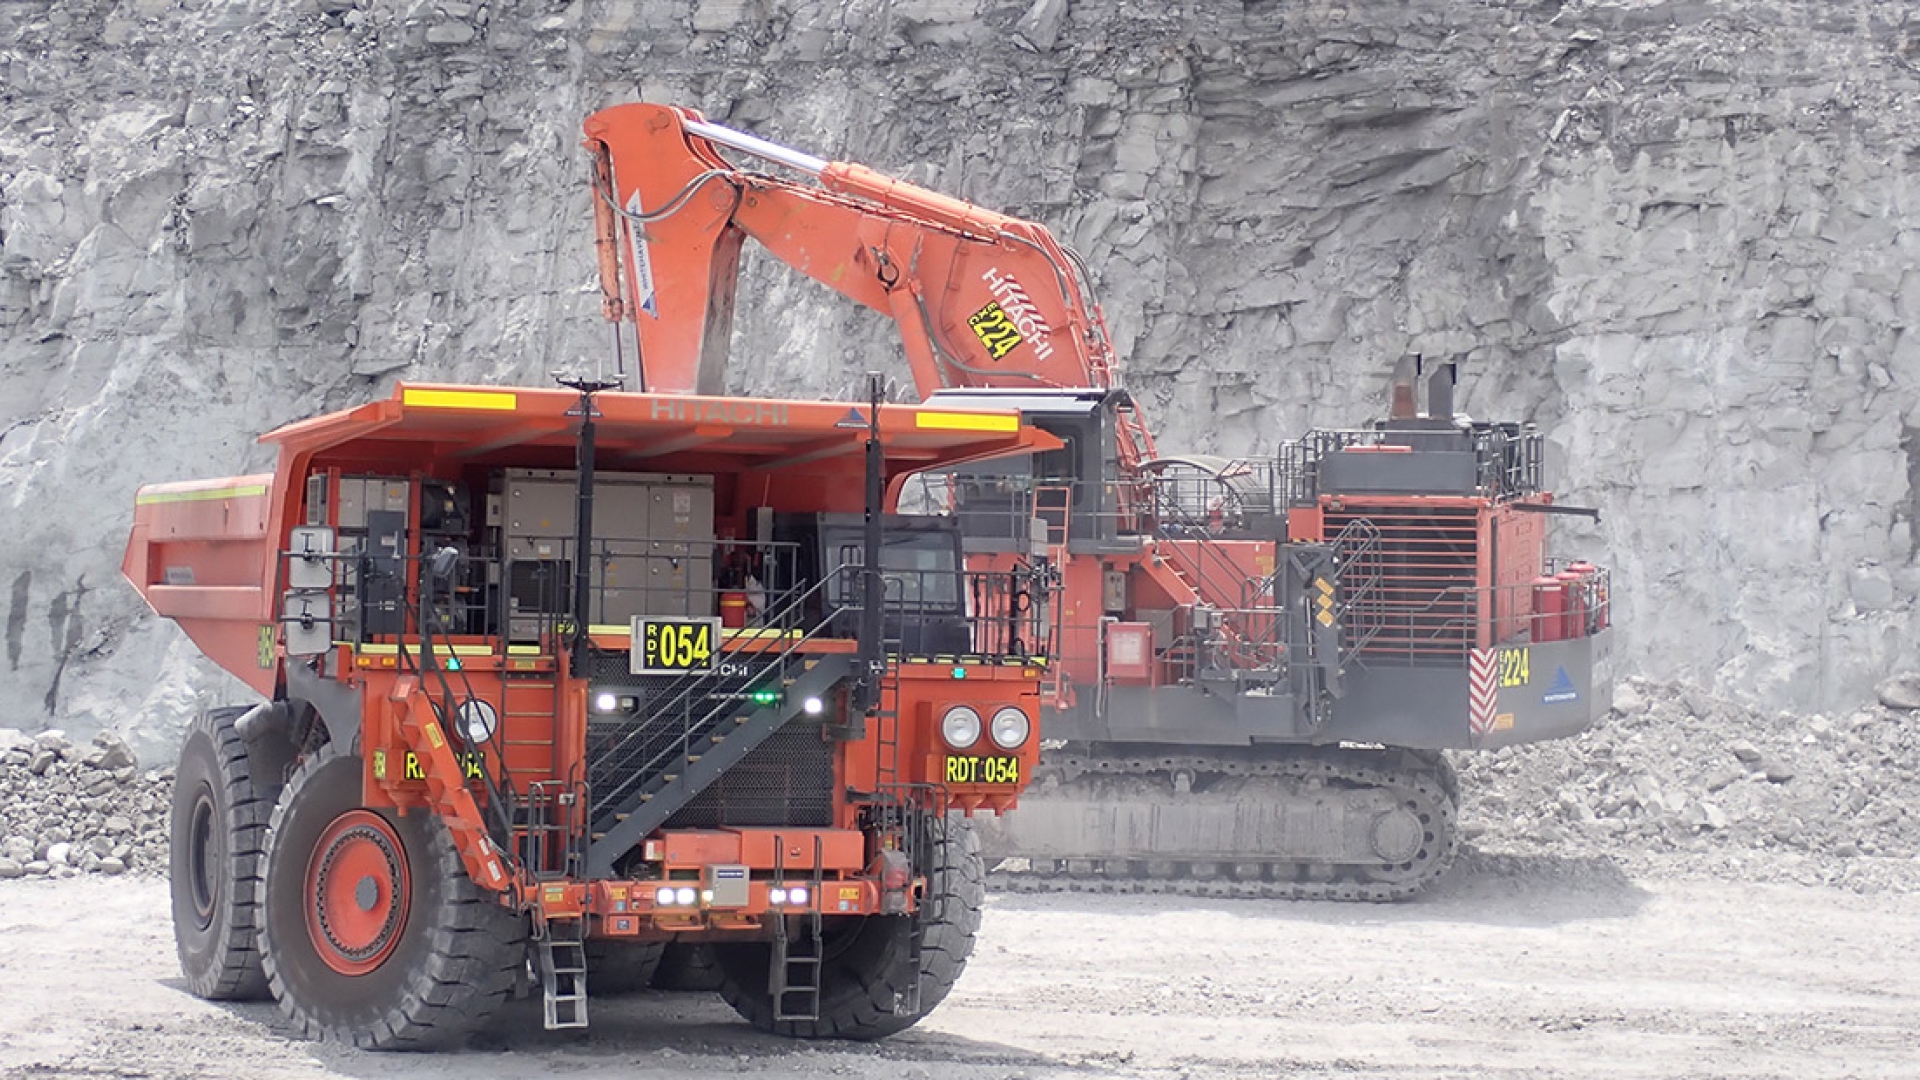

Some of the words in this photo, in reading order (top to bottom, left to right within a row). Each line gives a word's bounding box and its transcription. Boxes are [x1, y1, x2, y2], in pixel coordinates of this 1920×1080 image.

[973, 309, 1021, 358] 224
[982, 266, 1054, 361] HITACHI
[651, 398, 788, 426] HITACHI
[646, 623, 658, 667] RDT
[660, 624, 710, 668] 054
[1504, 647, 1530, 687] 224
[946, 756, 979, 783] RDT
[985, 756, 1018, 783] 054
